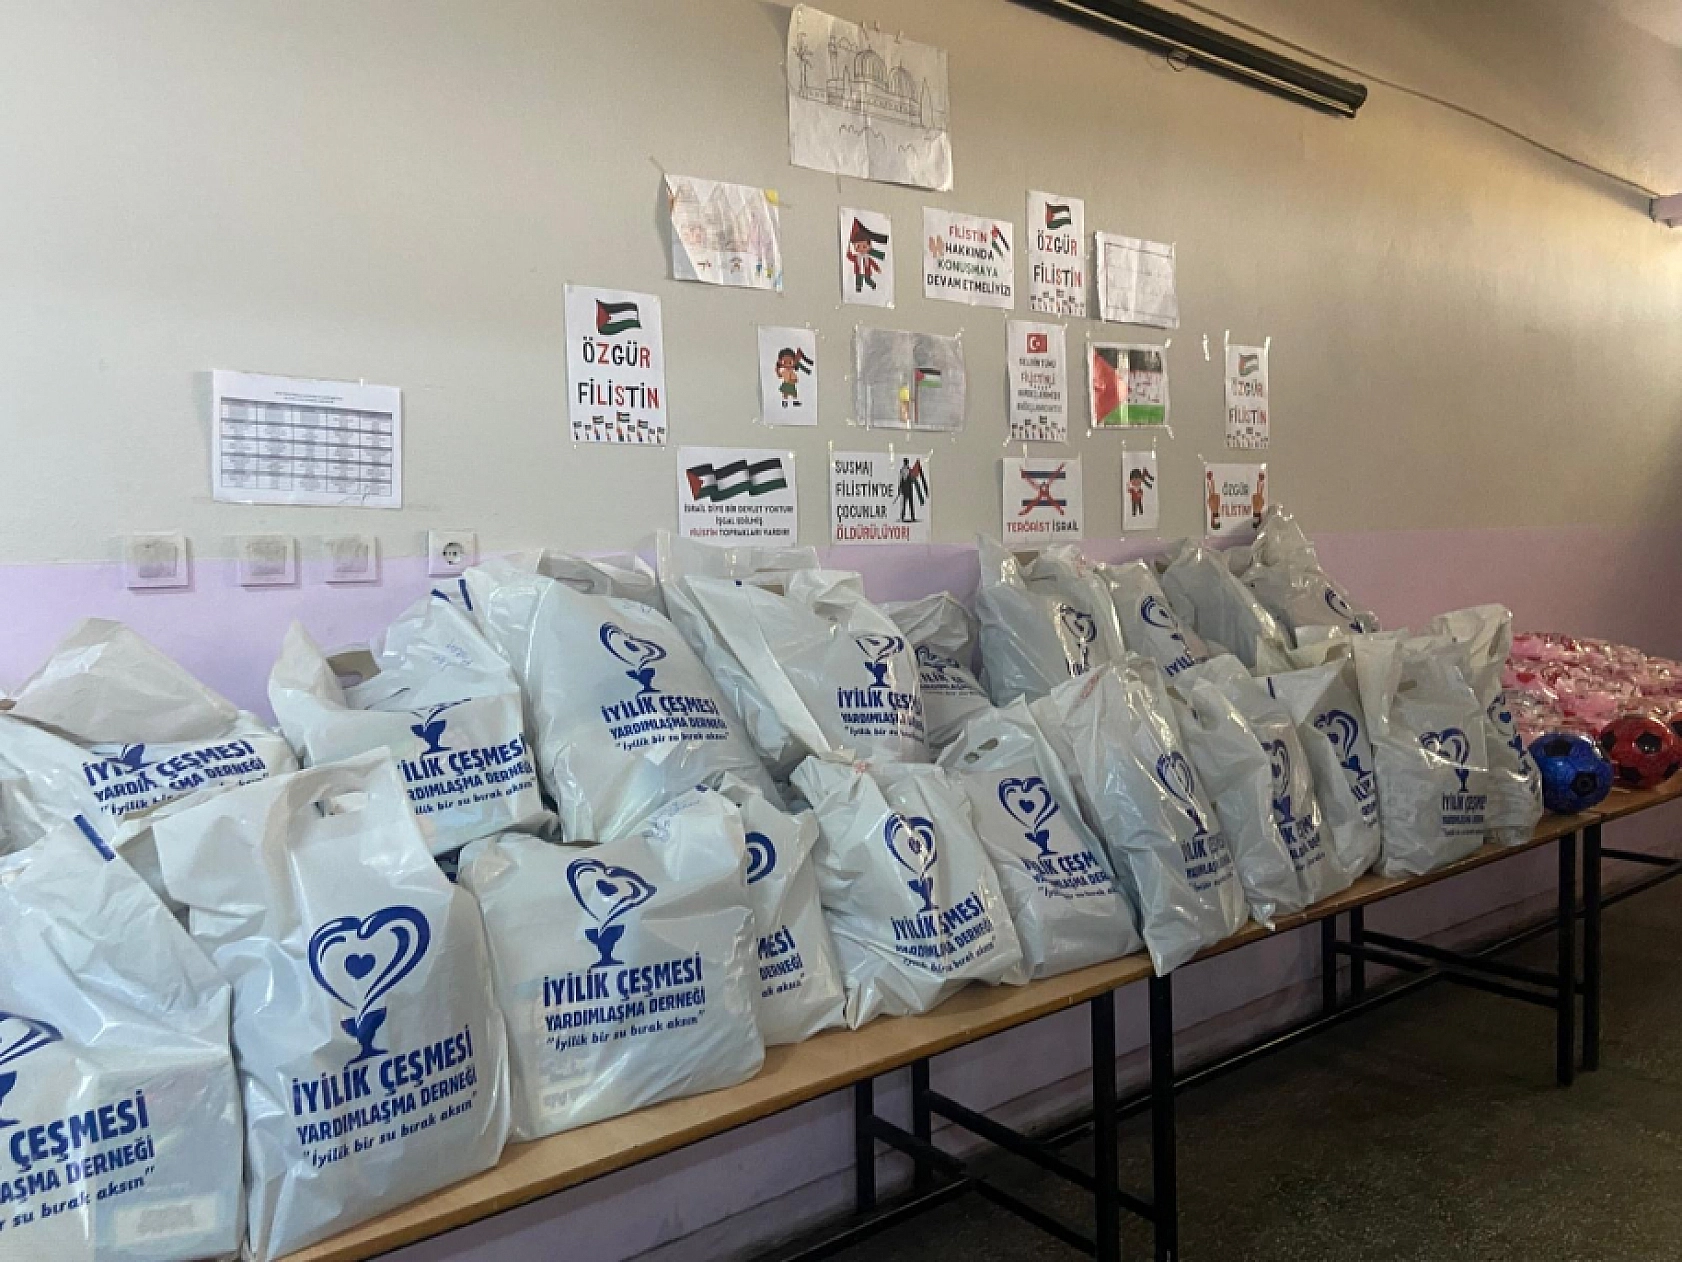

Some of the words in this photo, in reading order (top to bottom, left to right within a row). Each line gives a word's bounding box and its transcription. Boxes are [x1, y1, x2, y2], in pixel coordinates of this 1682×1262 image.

[949, 224, 987, 243] FİLİSTİN
[1037, 228, 1077, 256] ÖZGÜR
[945, 242, 994, 261] HAKKINDA
[927, 273, 961, 289] DEVAM
[1034, 261, 1082, 287] FİLİSTİN
[583, 336, 650, 368] ÖZGÜR
[578, 377, 659, 409] FİLİSTİN
[1231, 377, 1262, 397] ÖZGÜR
[1229, 405, 1266, 425] FİLİSTİN
[836, 480, 893, 498] FİLİSTİN'DE
[1007, 519, 1050, 532] TERÖRİST
[600, 694, 657, 723] İYİLİK
[837, 686, 884, 709] İYİLİK
[155, 739, 255, 780] ÇEŞMESİ
[757, 924, 795, 960] MESİ
[543, 968, 609, 1007] İYİLİK
[617, 951, 703, 1001] ÇEŞMESİ
[545, 1000, 645, 1032] YARDIMLAŞMA
[649, 986, 706, 1013] DERNEĞİ
[591, 1031, 610, 1044] bir
[613, 1030, 627, 1040] su
[630, 1020, 663, 1037] bırak
[292, 1064, 371, 1116] İYİLİK
[379, 1023, 474, 1097] ÇEŞMESİ
[296, 1092, 417, 1146] YARDIMLAŞMA
[420, 1064, 477, 1107] DERNEĞİ
[9, 1088, 150, 1174] ÇEŞMESİ
[354, 1136, 375, 1152] bir
[379, 1130, 396, 1145] su
[400, 1113, 437, 1138] bırak
[66, 1135, 156, 1185] DERNEĞİ
[13, 1211, 34, 1227] su
[41, 1191, 91, 1219] bırak
